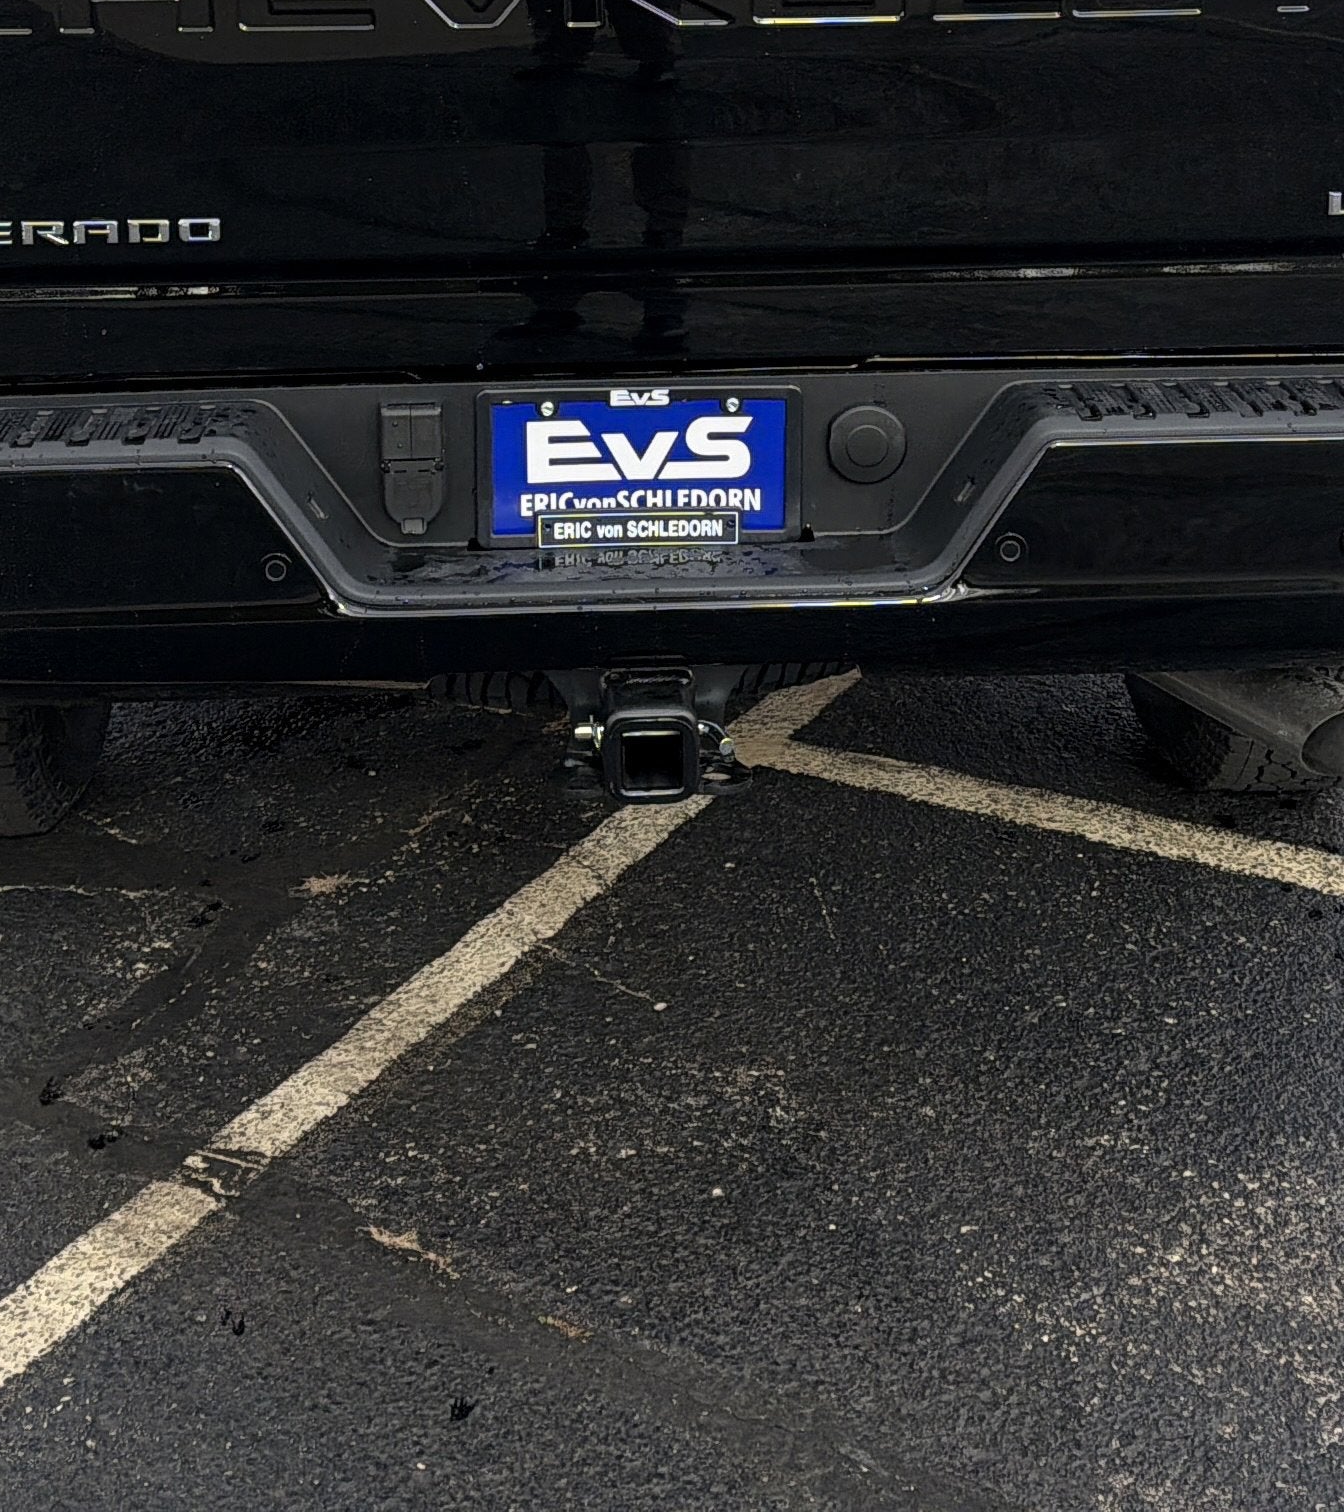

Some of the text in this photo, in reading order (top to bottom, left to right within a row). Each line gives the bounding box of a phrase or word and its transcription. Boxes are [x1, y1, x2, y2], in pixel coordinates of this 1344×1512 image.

[553, 519, 723, 540] ERIC von SCHLEDORN
